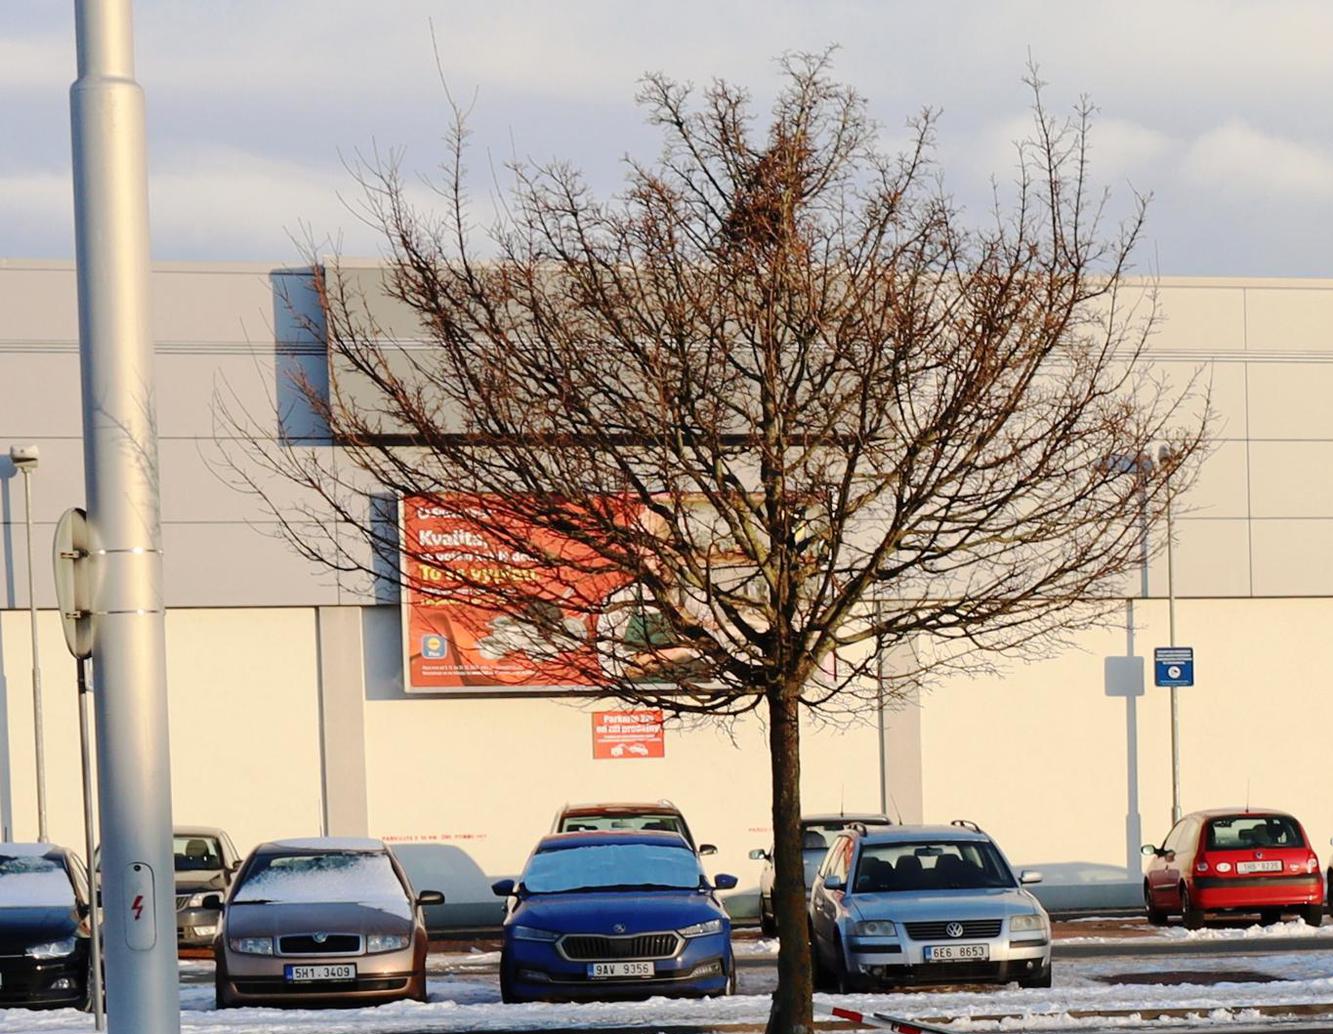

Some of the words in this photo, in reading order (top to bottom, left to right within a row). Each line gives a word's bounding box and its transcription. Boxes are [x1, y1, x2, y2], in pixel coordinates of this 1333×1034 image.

[420, 564, 442, 580] To
[933, 948, 953, 958] 6E6
[959, 946, 985, 957] 8653
[295, 967, 315, 978] 5H1
[323, 966, 351, 978] 3409
[596, 964, 616, 975] 9AV
[623, 963, 650, 975] 9356
